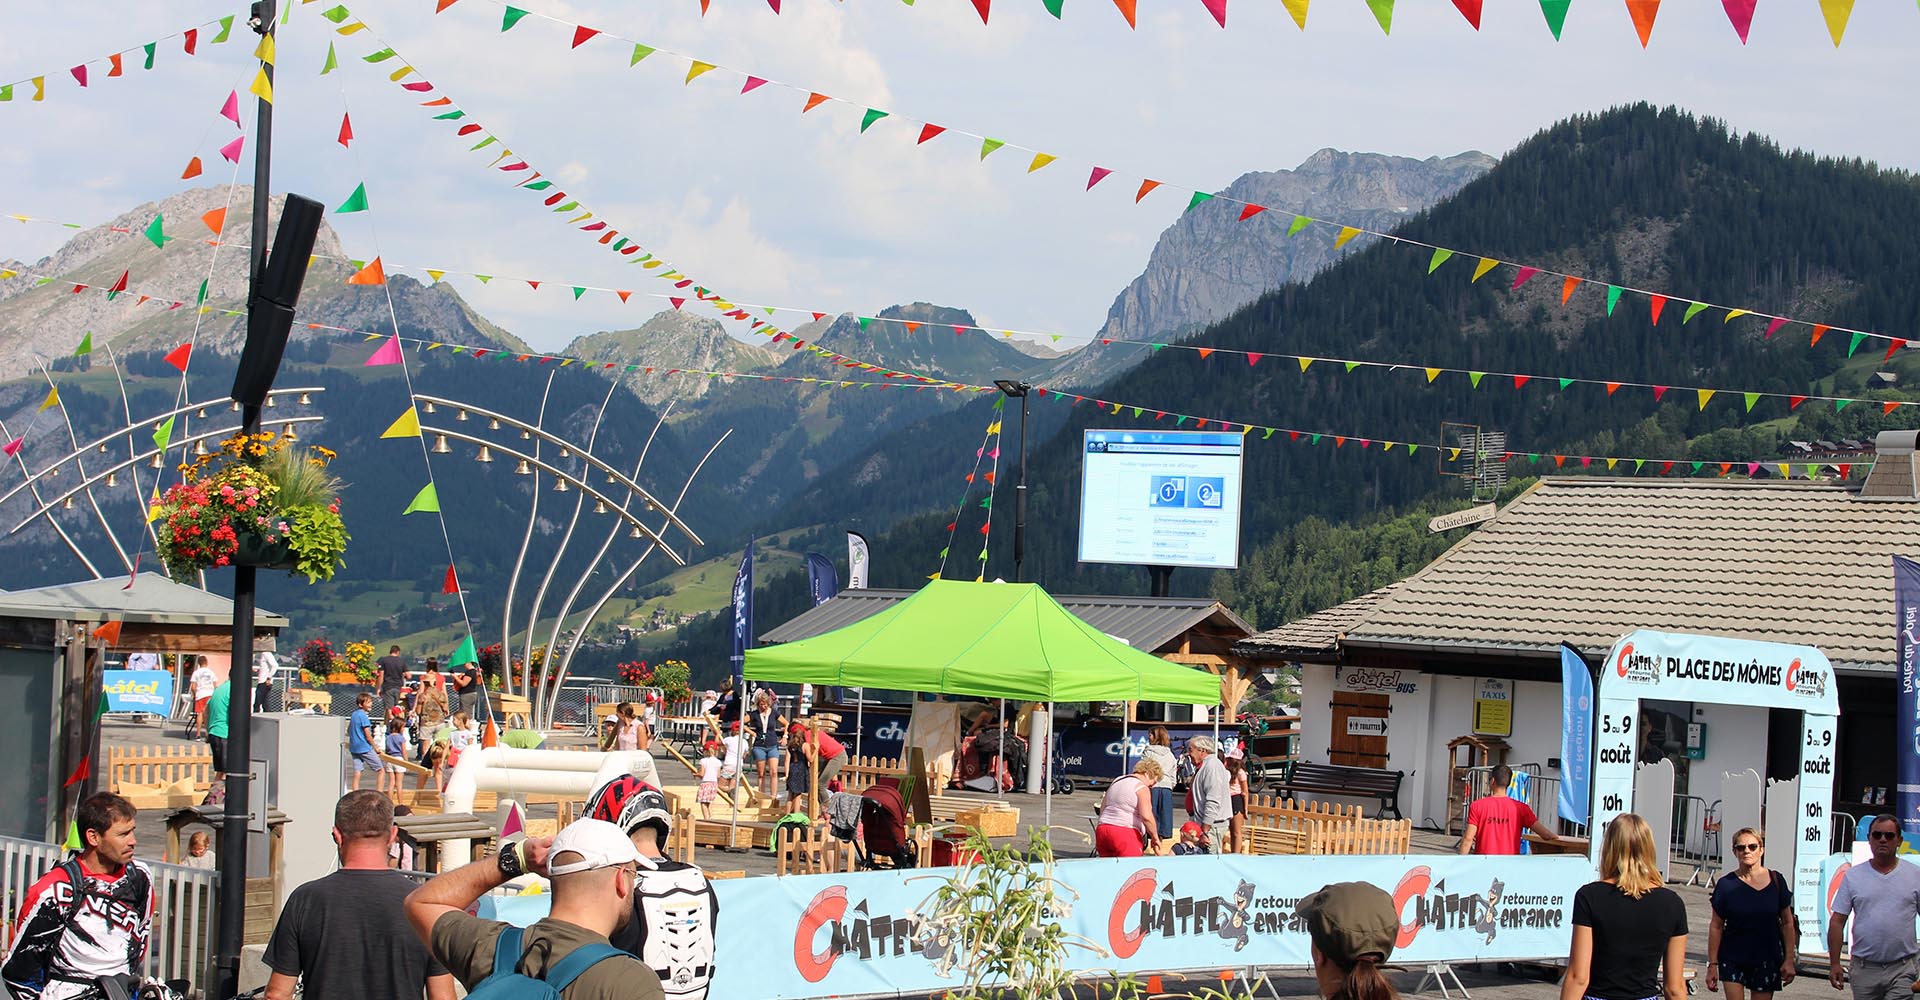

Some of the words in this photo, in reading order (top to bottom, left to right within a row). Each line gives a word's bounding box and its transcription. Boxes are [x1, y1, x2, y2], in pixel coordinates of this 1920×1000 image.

[1666, 656, 1711, 681] PLACE
[1711, 660, 1736, 682] DES
[1736, 658, 1782, 686] MÔMES
[1346, 668, 1402, 689] châtel
[1396, 682, 1417, 694] BUS
[1481, 690, 1507, 700] TAXIS
[1359, 723, 1381, 731] TOILETTES
[1602, 714, 1611, 734] 5
[1622, 715, 1632, 734] 9
[1806, 728, 1813, 747] 5
[1822, 730, 1832, 747] 9
[1600, 742, 1632, 764] août
[1804, 754, 1831, 775] août
[1602, 793, 1623, 812] 10h
[1805, 801, 1823, 818] 10h
[1805, 825, 1821, 842] 18h
[1255, 896, 1304, 909] retour
[1393, 865, 1478, 949] CHÂTEL
[1503, 892, 1548, 906] retourne
[1550, 895, 1564, 906] en
[1108, 867, 1220, 959] CHÂTEL
[1500, 907, 1564, 929] enfance
